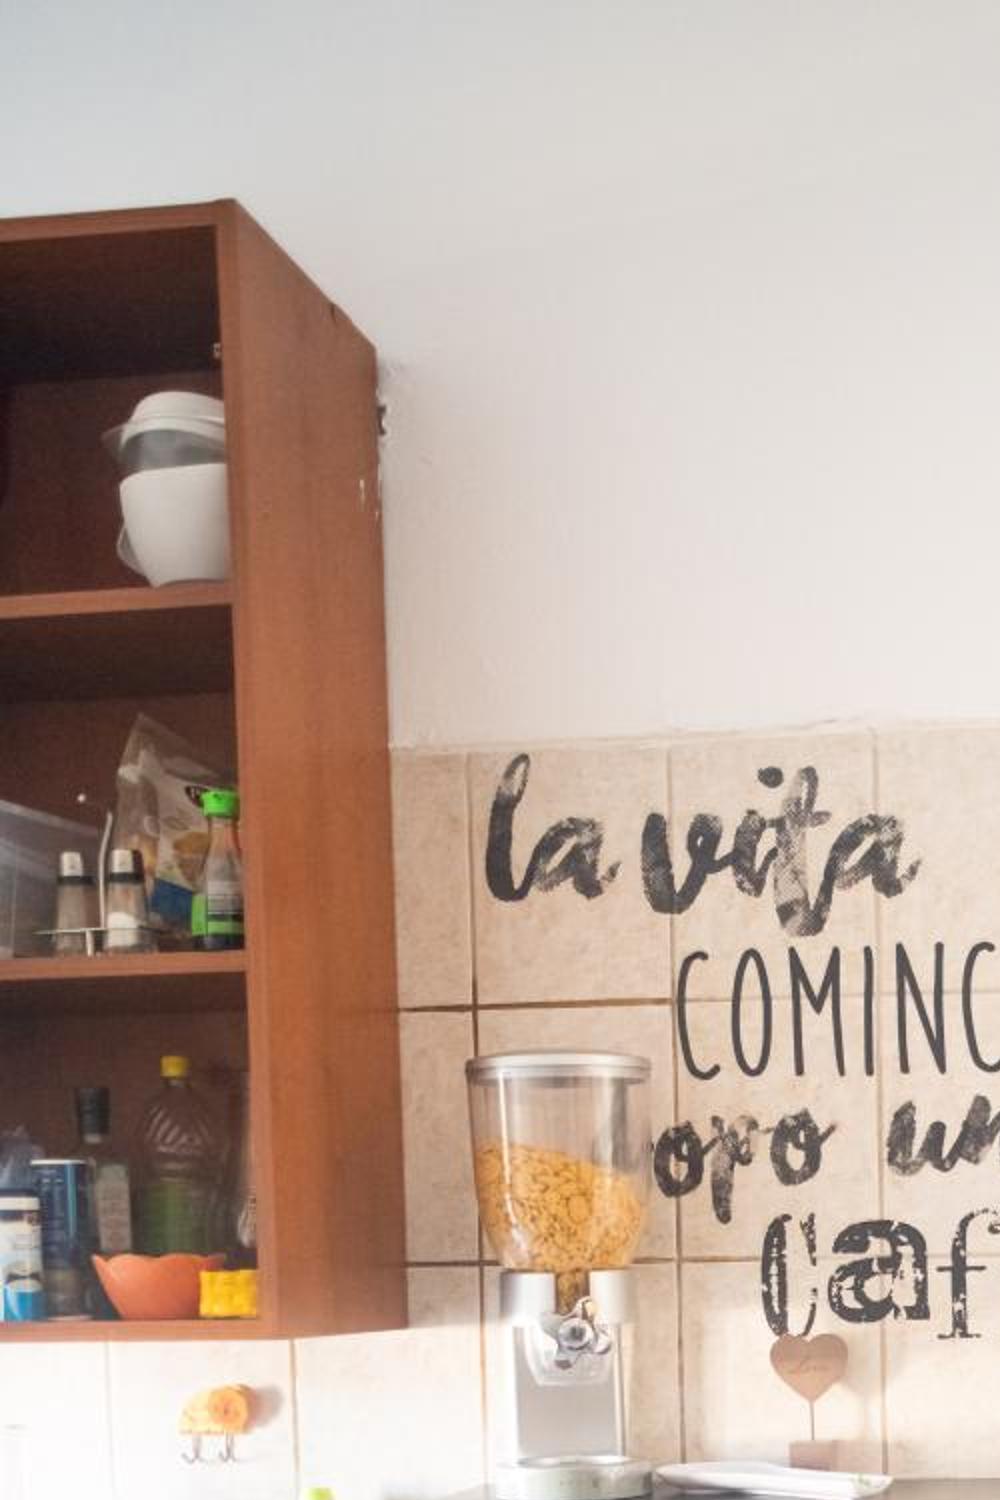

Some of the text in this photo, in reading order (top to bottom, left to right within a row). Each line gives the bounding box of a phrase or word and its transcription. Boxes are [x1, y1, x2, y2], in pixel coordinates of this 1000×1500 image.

[484, 753, 919, 936] la vita
[651, 1109, 836, 1224] opo
